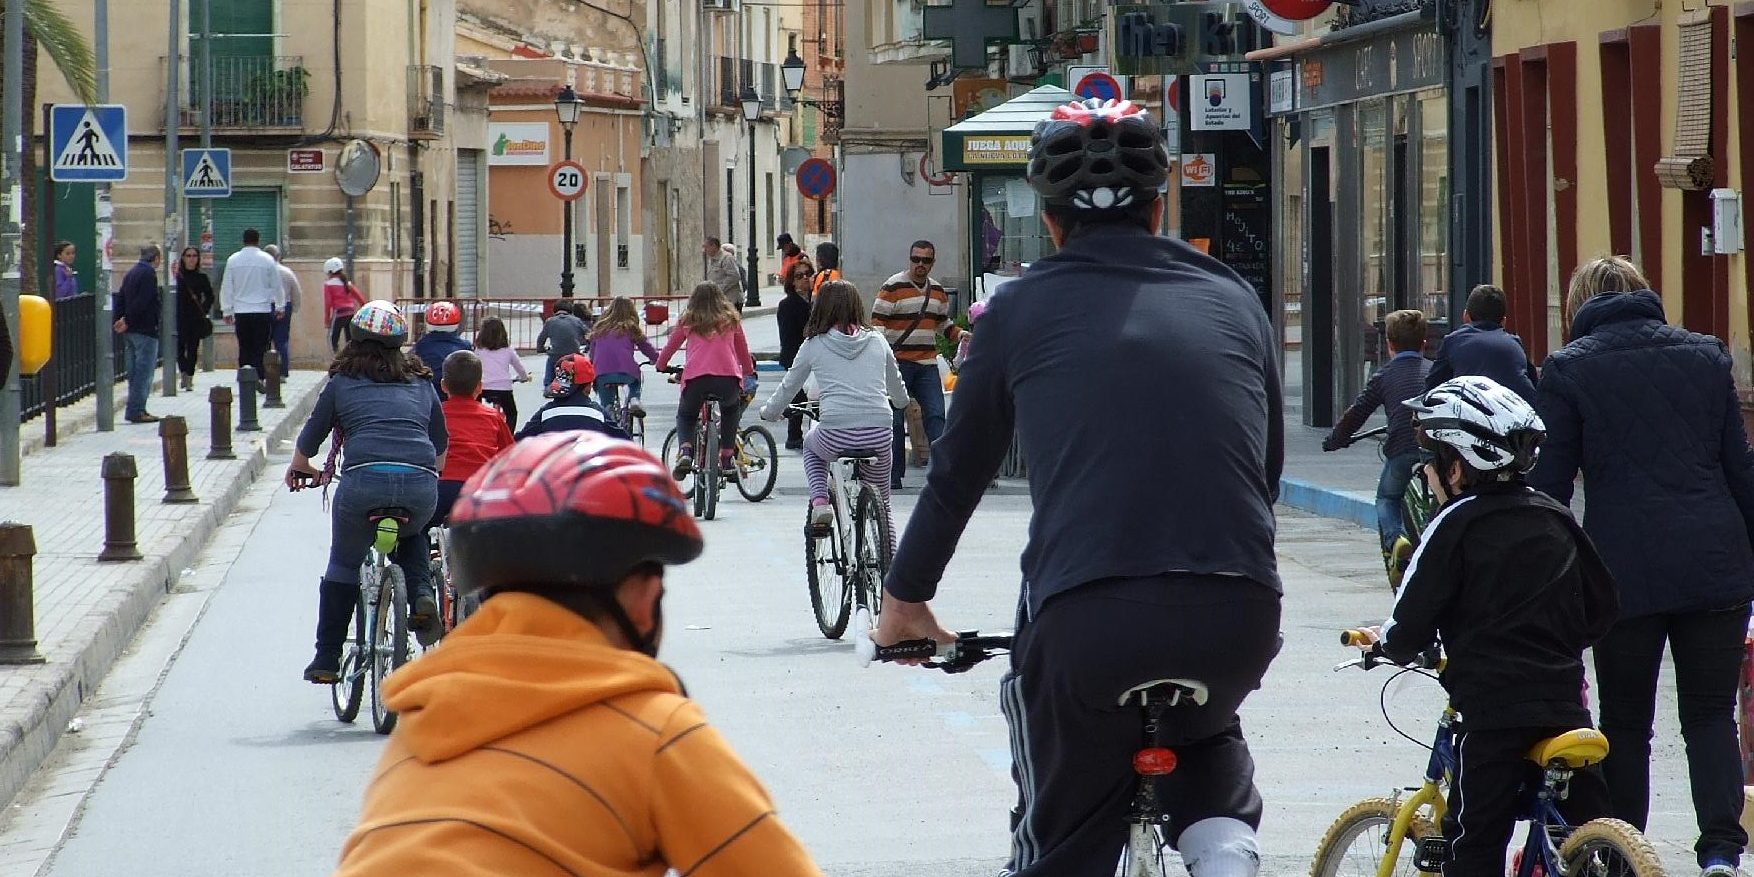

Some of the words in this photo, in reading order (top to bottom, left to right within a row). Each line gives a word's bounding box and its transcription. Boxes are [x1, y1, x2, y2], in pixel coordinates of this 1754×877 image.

[1249, 1, 1270, 23] SPORT
[1412, 32, 1438, 79] SPORT
[967, 140, 1001, 151] JUEGA
[558, 173, 578, 187] 20
